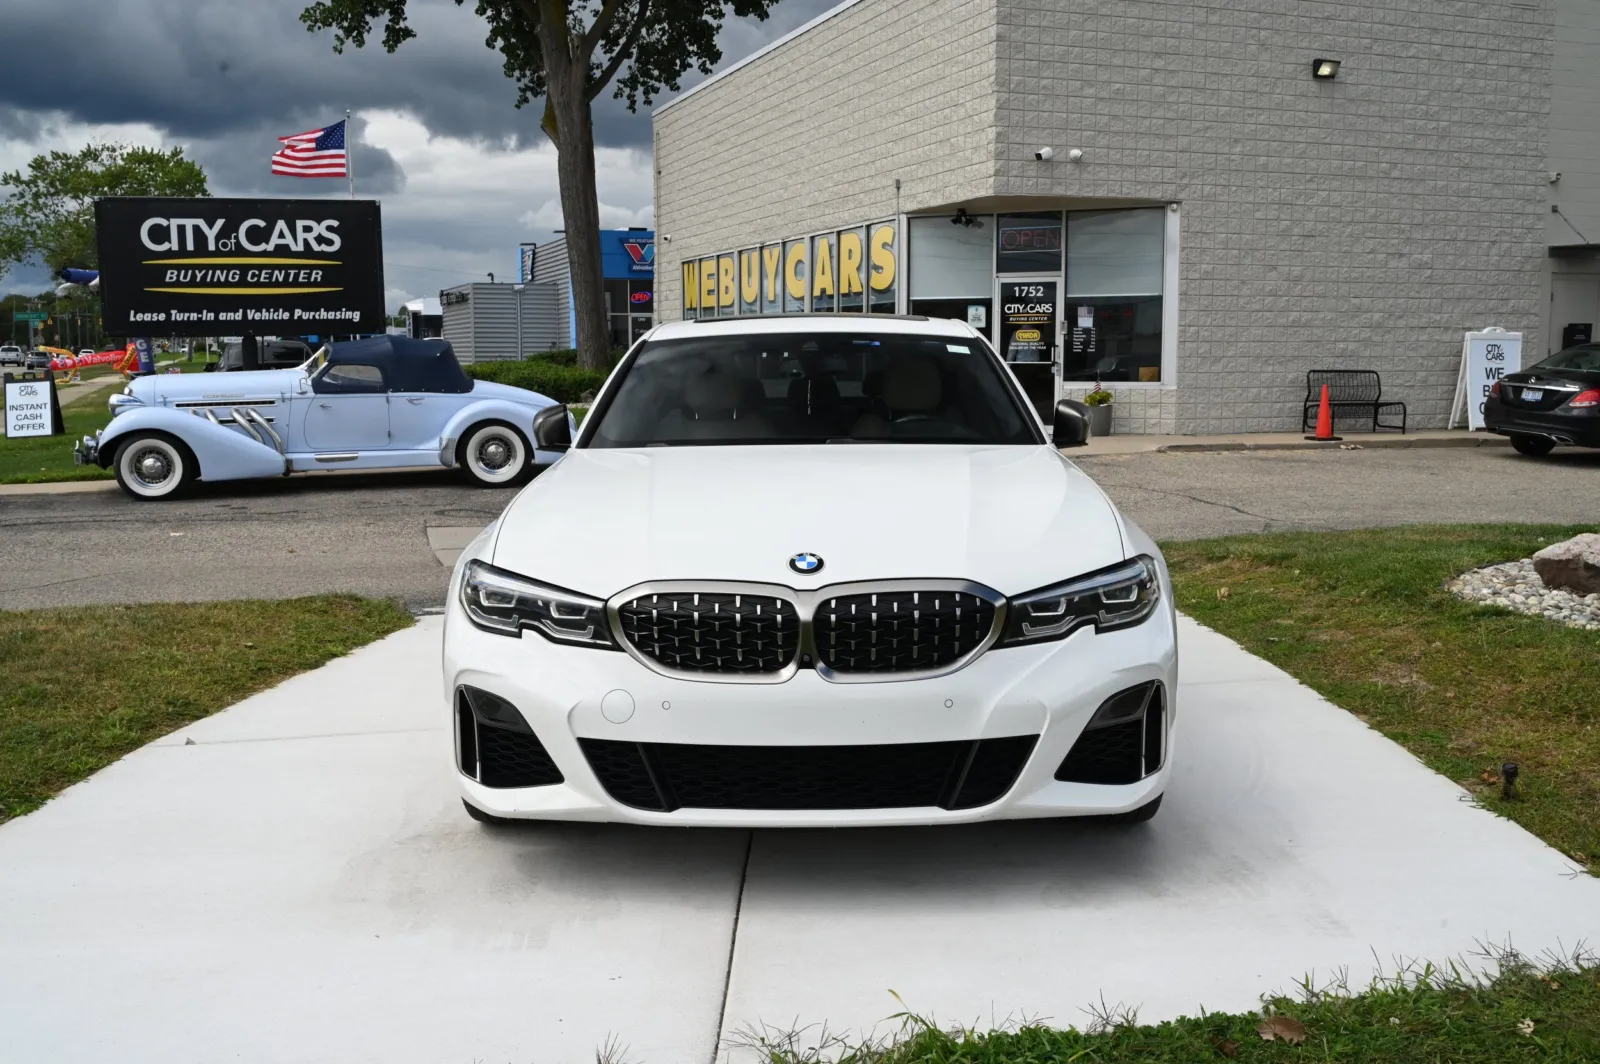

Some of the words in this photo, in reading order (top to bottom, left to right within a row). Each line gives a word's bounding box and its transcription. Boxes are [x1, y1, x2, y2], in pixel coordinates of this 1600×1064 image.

[140, 217, 226, 252] CITY
[219, 233, 238, 252] of
[238, 218, 342, 253] CARS
[1002, 229, 1060, 249] OPEN
[165, 269, 240, 282] BUYING
[247, 269, 323, 282] CENTER
[1014, 286, 1044, 297] 1752
[1004, 304, 1025, 313] CITY
[1028, 304, 1052, 313] CARS
[130, 310, 166, 322] Lease
[170, 310, 214, 321] Turn-In
[219, 309, 242, 321] and
[247, 308, 290, 320] Vehicle
[294, 308, 360, 322] Purchasing
[1486, 344, 1501, 353] CITY
[1486, 352, 1505, 361] CARS
[1485, 368, 1504, 380] WE
[9, 402, 48, 412] INSTANT
[16, 413, 42, 422] CASH
[14, 423, 46, 432] OFFER
